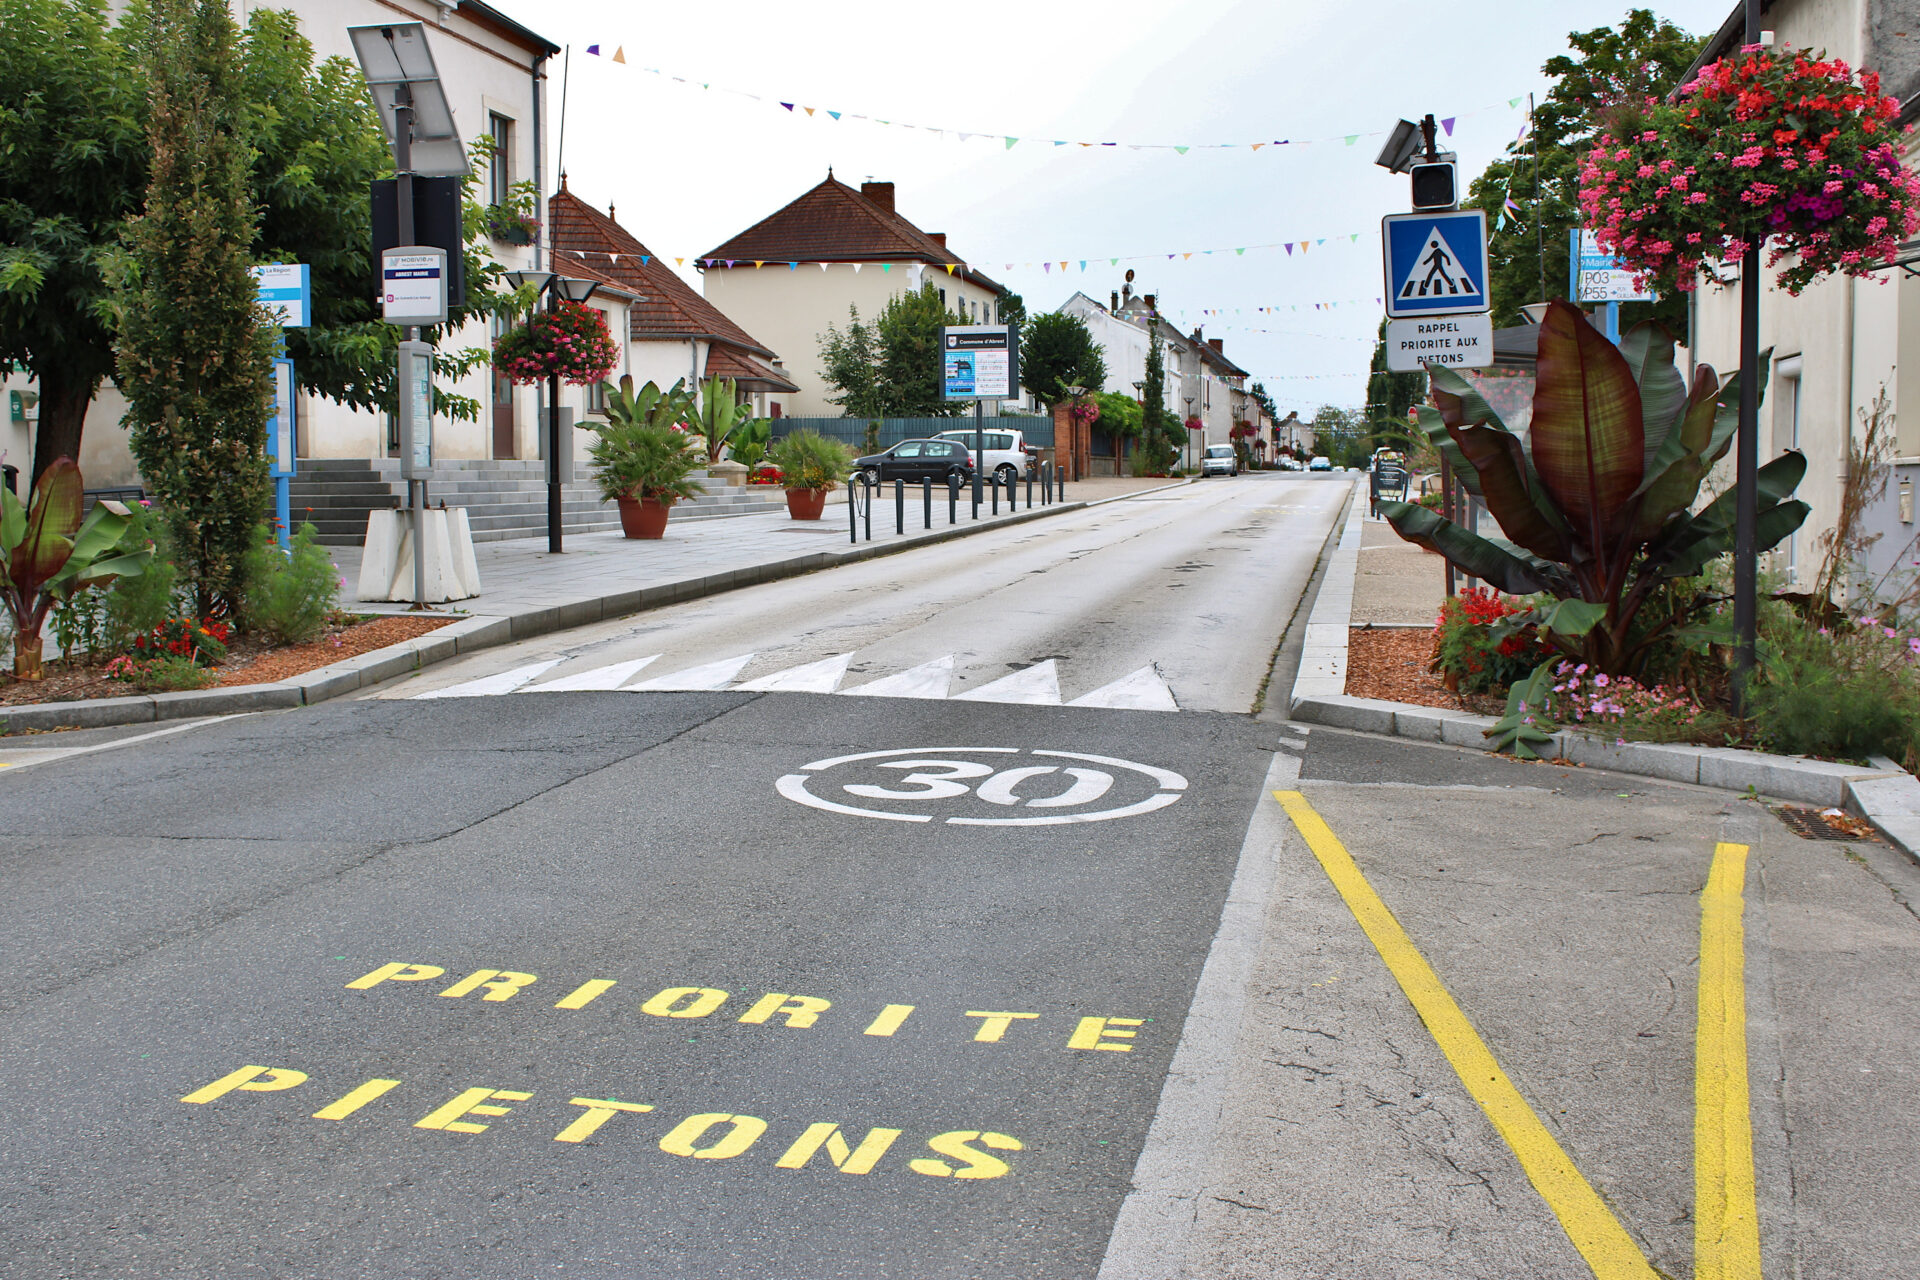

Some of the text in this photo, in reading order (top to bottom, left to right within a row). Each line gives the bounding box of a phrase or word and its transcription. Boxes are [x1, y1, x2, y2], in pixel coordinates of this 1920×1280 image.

[1585, 258, 1612, 267] Mairie
[1585, 272, 1609, 284] P03
[1585, 287, 1607, 299] P55
[1418, 323, 1460, 333] RAPPEL
[1401, 337, 1478, 350] PRIORITE AUX
[843, 760, 1114, 807] 30
[345, 962, 1143, 1052] PRIORITE
[180, 1064, 1023, 1180] PIETONS
